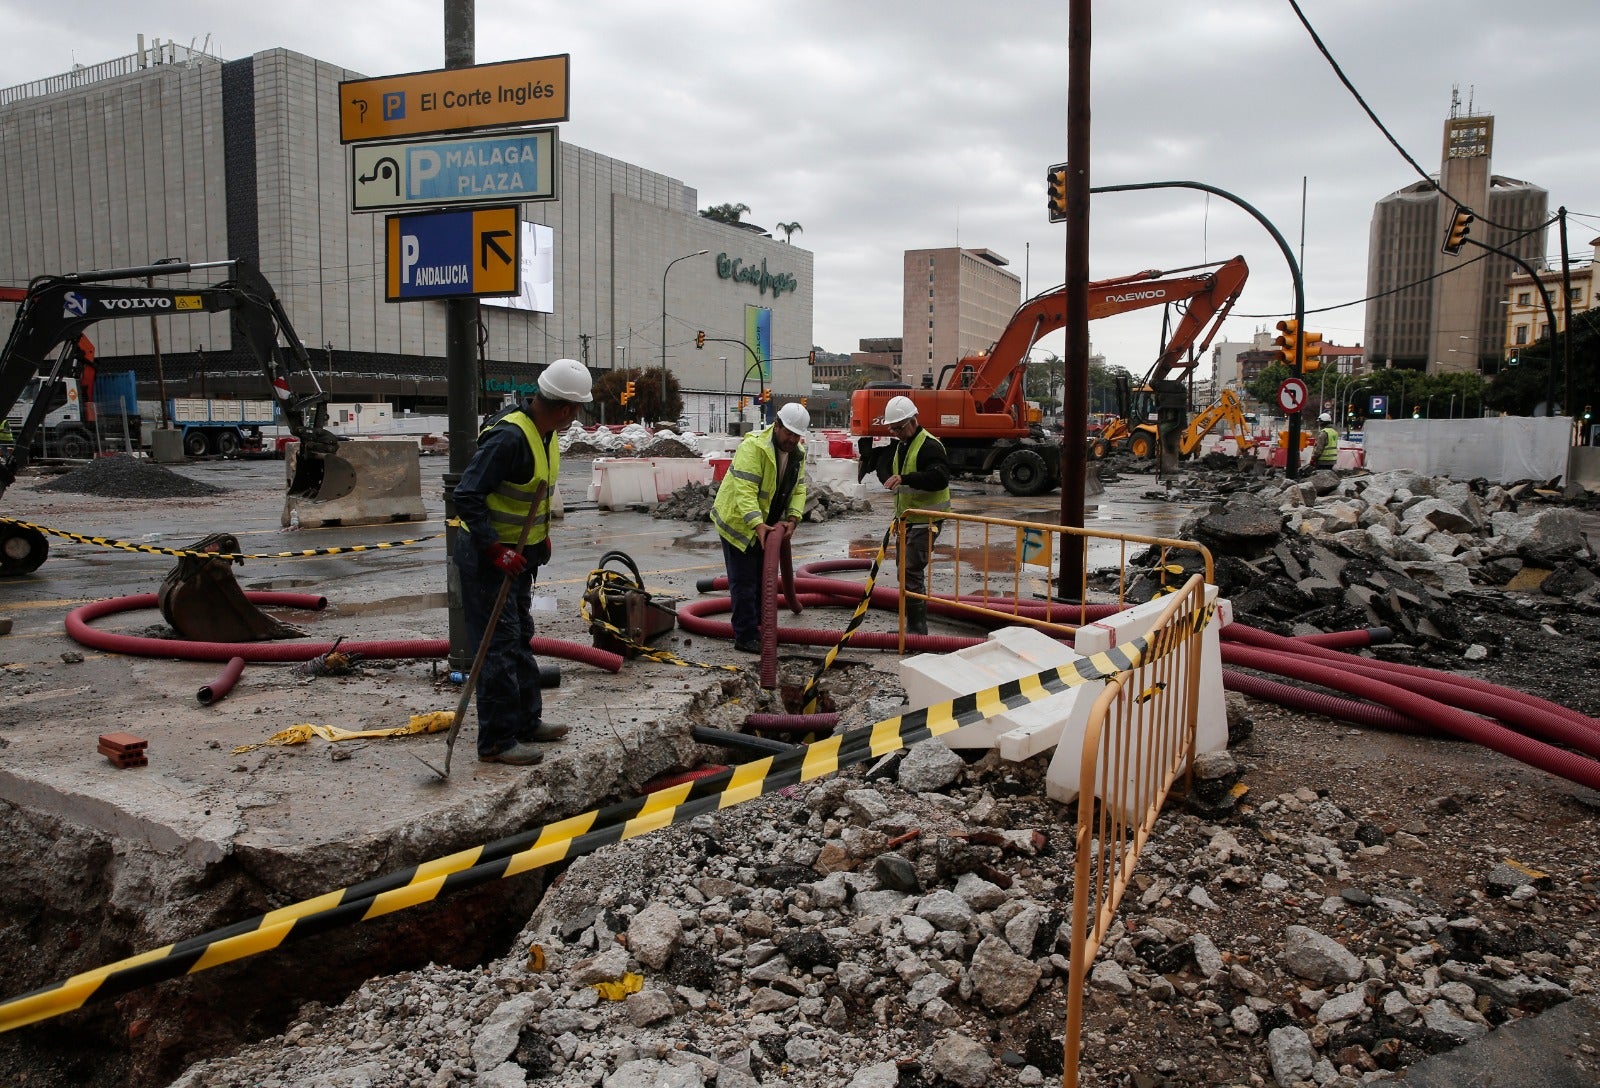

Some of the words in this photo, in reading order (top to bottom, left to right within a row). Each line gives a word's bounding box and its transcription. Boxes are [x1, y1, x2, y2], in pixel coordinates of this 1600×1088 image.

[387, 95, 401, 118] P
[421, 93, 437, 111] El
[443, 88, 491, 109] Corte
[498, 80, 554, 106] Inglés
[410, 149, 441, 196] P
[446, 145, 534, 169] MÁLAGA
[458, 172, 524, 193] PLAZA
[415, 264, 468, 287] ANDALUCIA
[100, 298, 171, 309] VOLVO
[1105, 289, 1166, 302] DAEWOO
[1372, 398, 1382, 409] P
